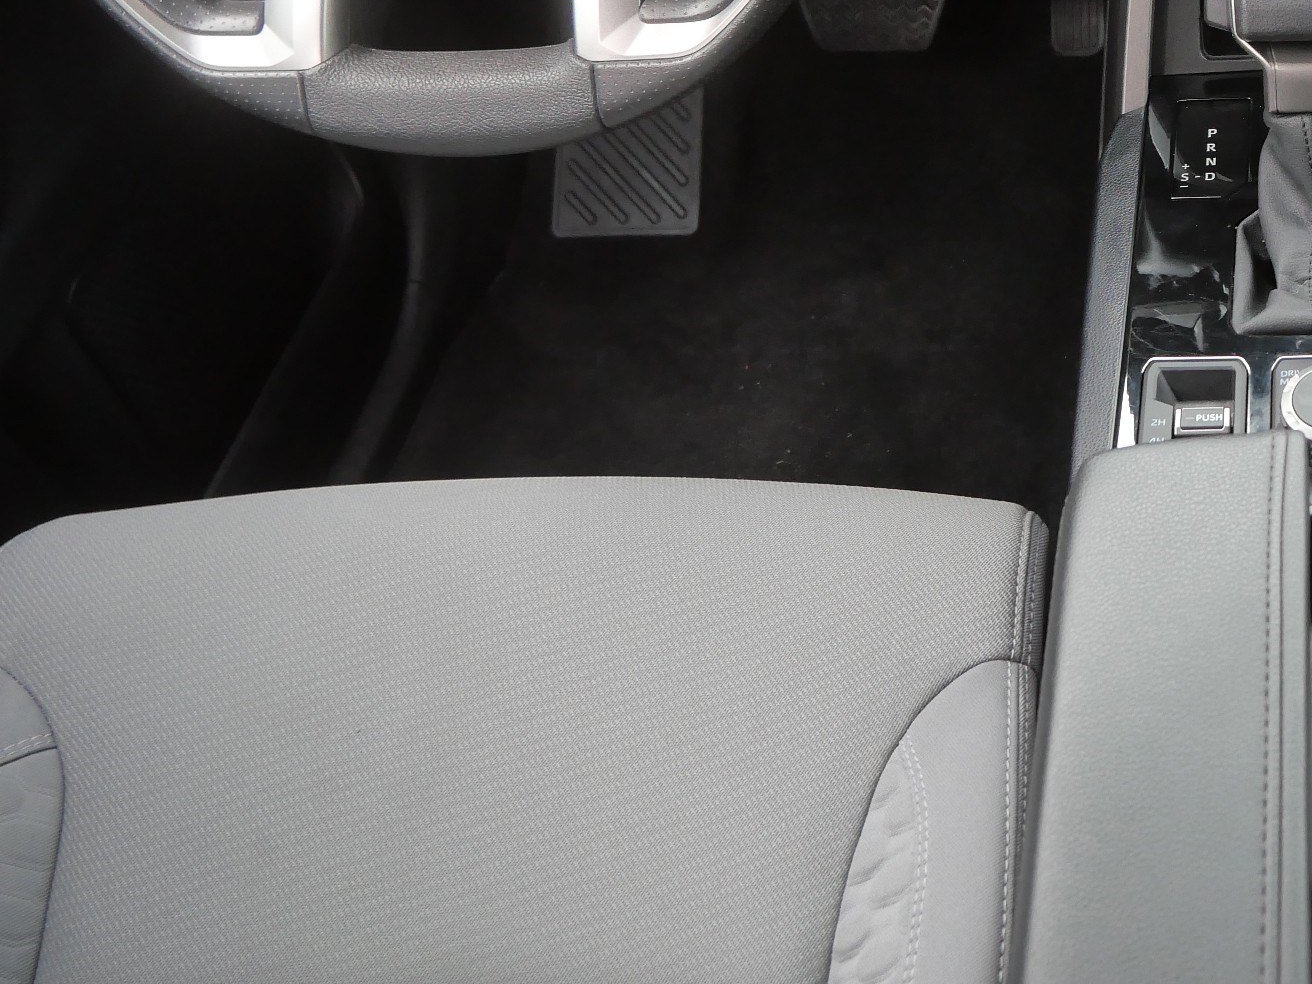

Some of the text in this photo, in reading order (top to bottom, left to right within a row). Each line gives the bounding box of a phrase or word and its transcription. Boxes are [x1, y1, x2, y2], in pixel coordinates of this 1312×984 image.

[1207, 128, 1218, 138] P
[1205, 143, 1217, 152] R
[1205, 157, 1217, 166] N
[1180, 172, 1190, 182] S
[1204, 172, 1216, 181] D
[1195, 413, 1223, 422] PUSH
[1150, 418, 1166, 427] 2H
